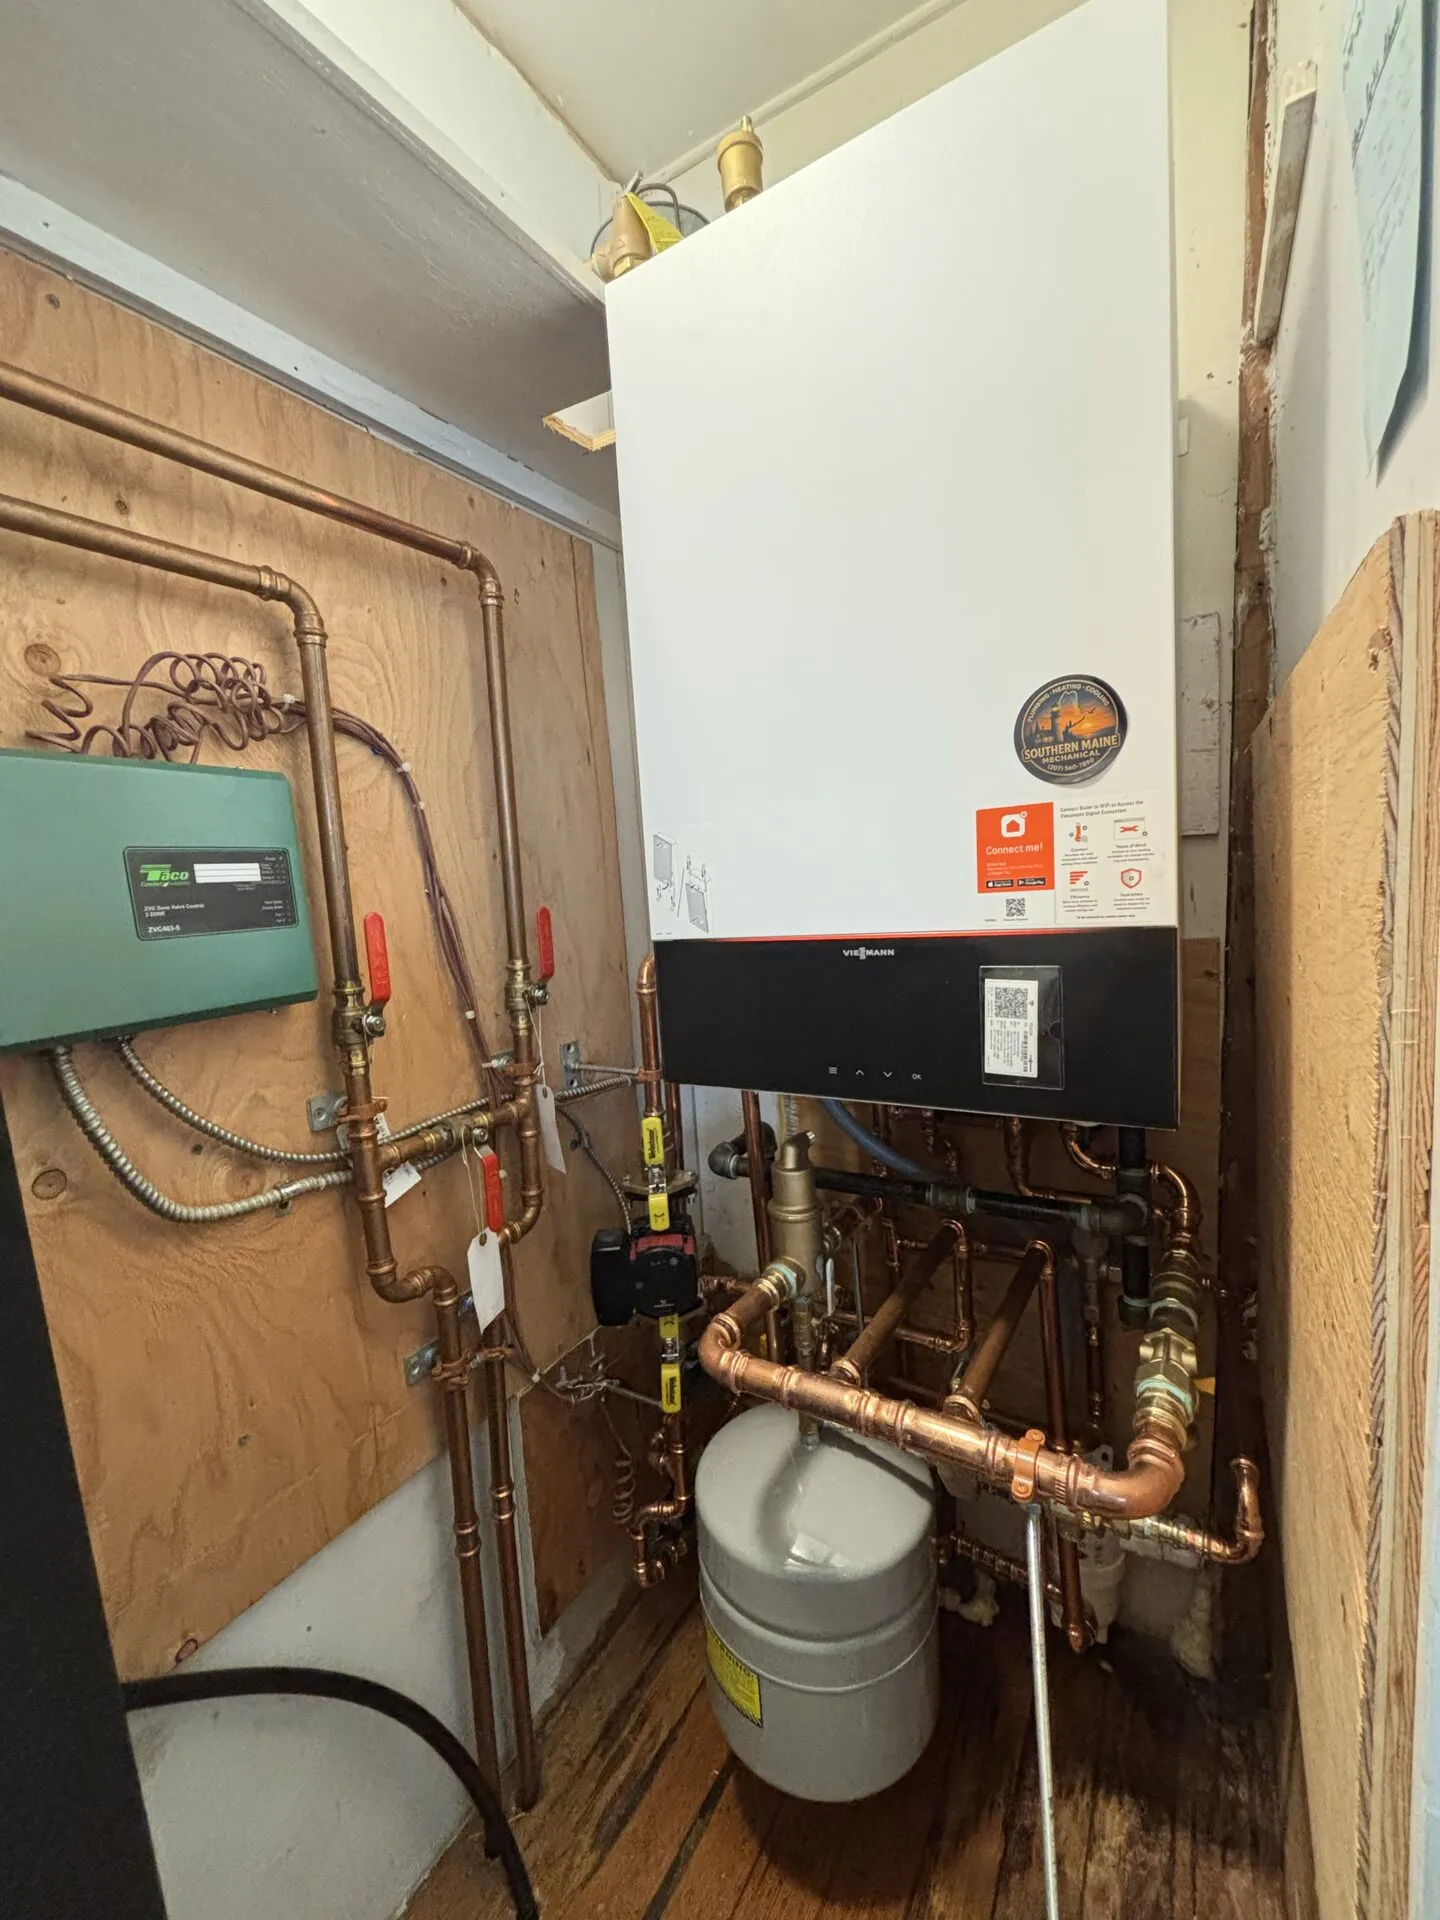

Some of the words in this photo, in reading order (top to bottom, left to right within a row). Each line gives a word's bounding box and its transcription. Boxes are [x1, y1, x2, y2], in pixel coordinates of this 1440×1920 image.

[1027, 692, 1050, 723] PLUMBING
[1051, 683, 1082, 694] HEATING
[1085, 685, 1110, 706] COOLING
[1024, 741, 1079, 760] SOUTHERN
[1081, 735, 1118, 750] MAINE
[1042, 750, 1101, 764] MECHANICAL
[985, 845, 1024, 856] Connect
[1025, 841, 1043, 852] me!
[140, 863, 190, 882] Taco
[842, 946, 895, 960] VIESSMANN
